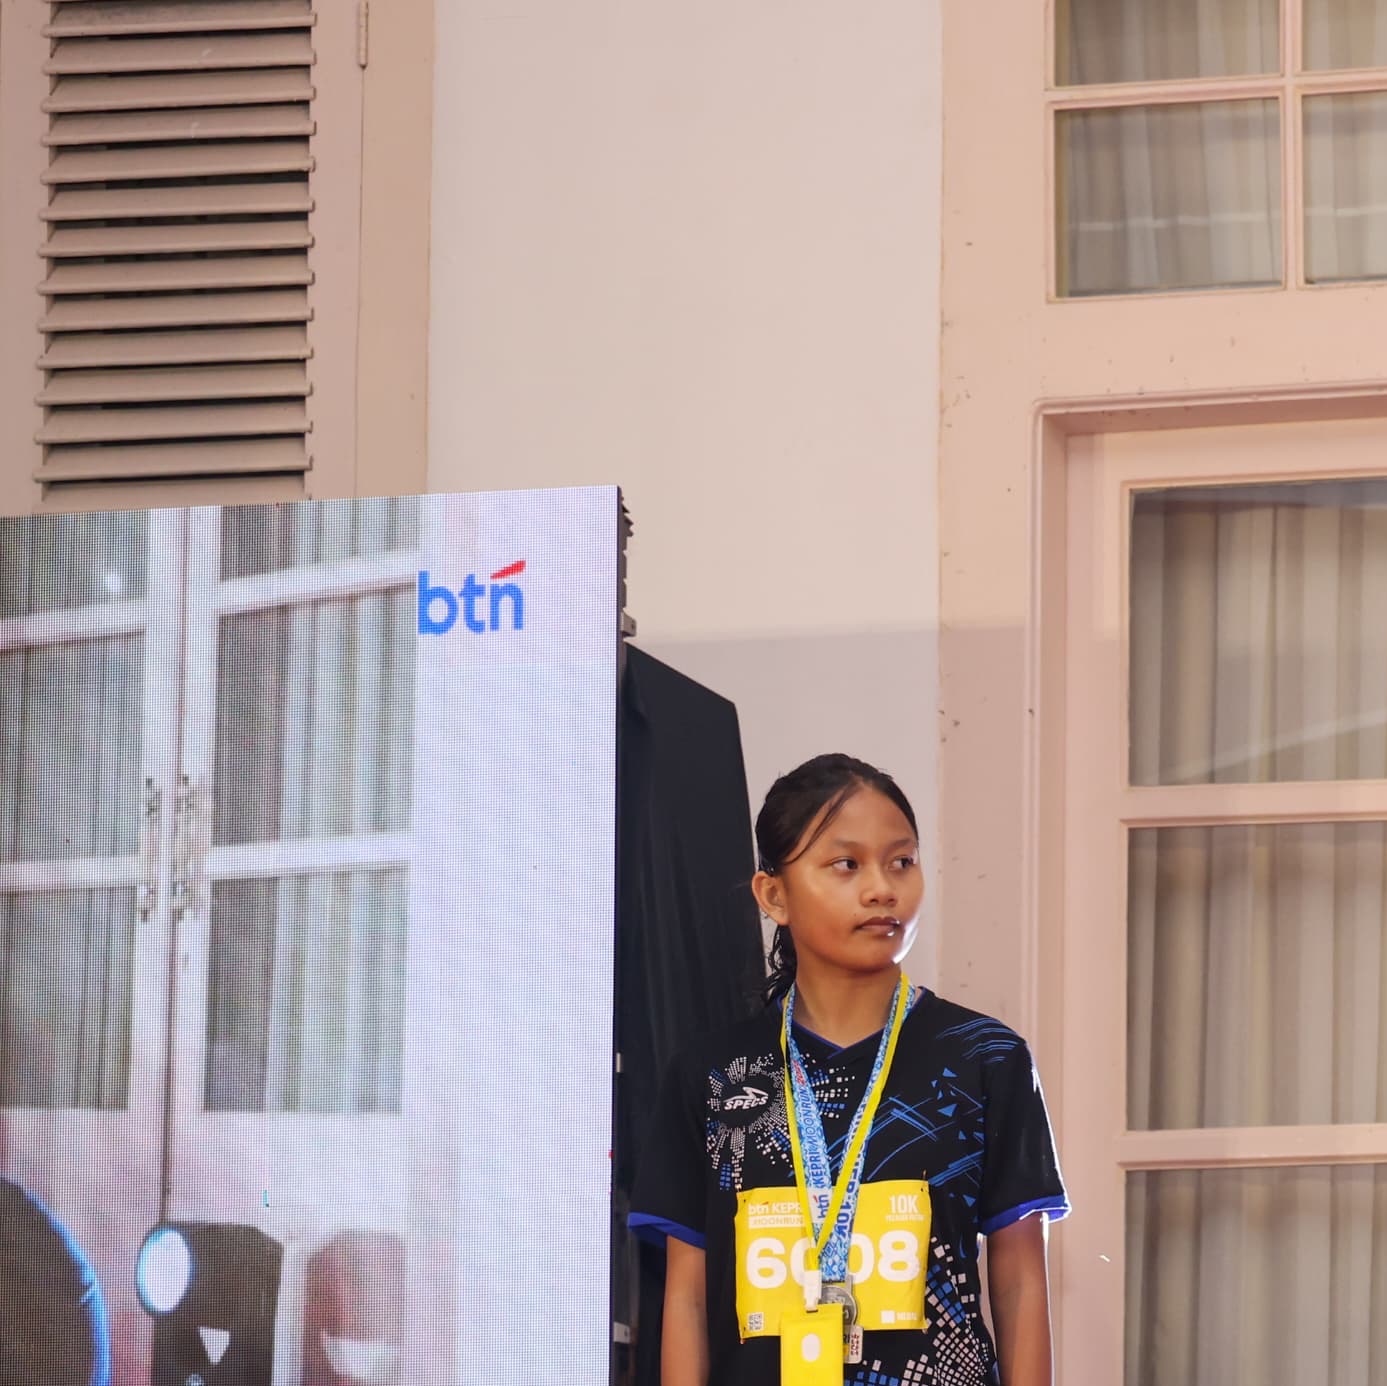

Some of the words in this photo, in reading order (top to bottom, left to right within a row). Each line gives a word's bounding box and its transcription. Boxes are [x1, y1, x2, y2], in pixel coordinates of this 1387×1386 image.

[418, 560, 526, 635] btn
[809, 1151, 824, 1188] KEPRI
[889, 1194, 919, 1213] 10K
